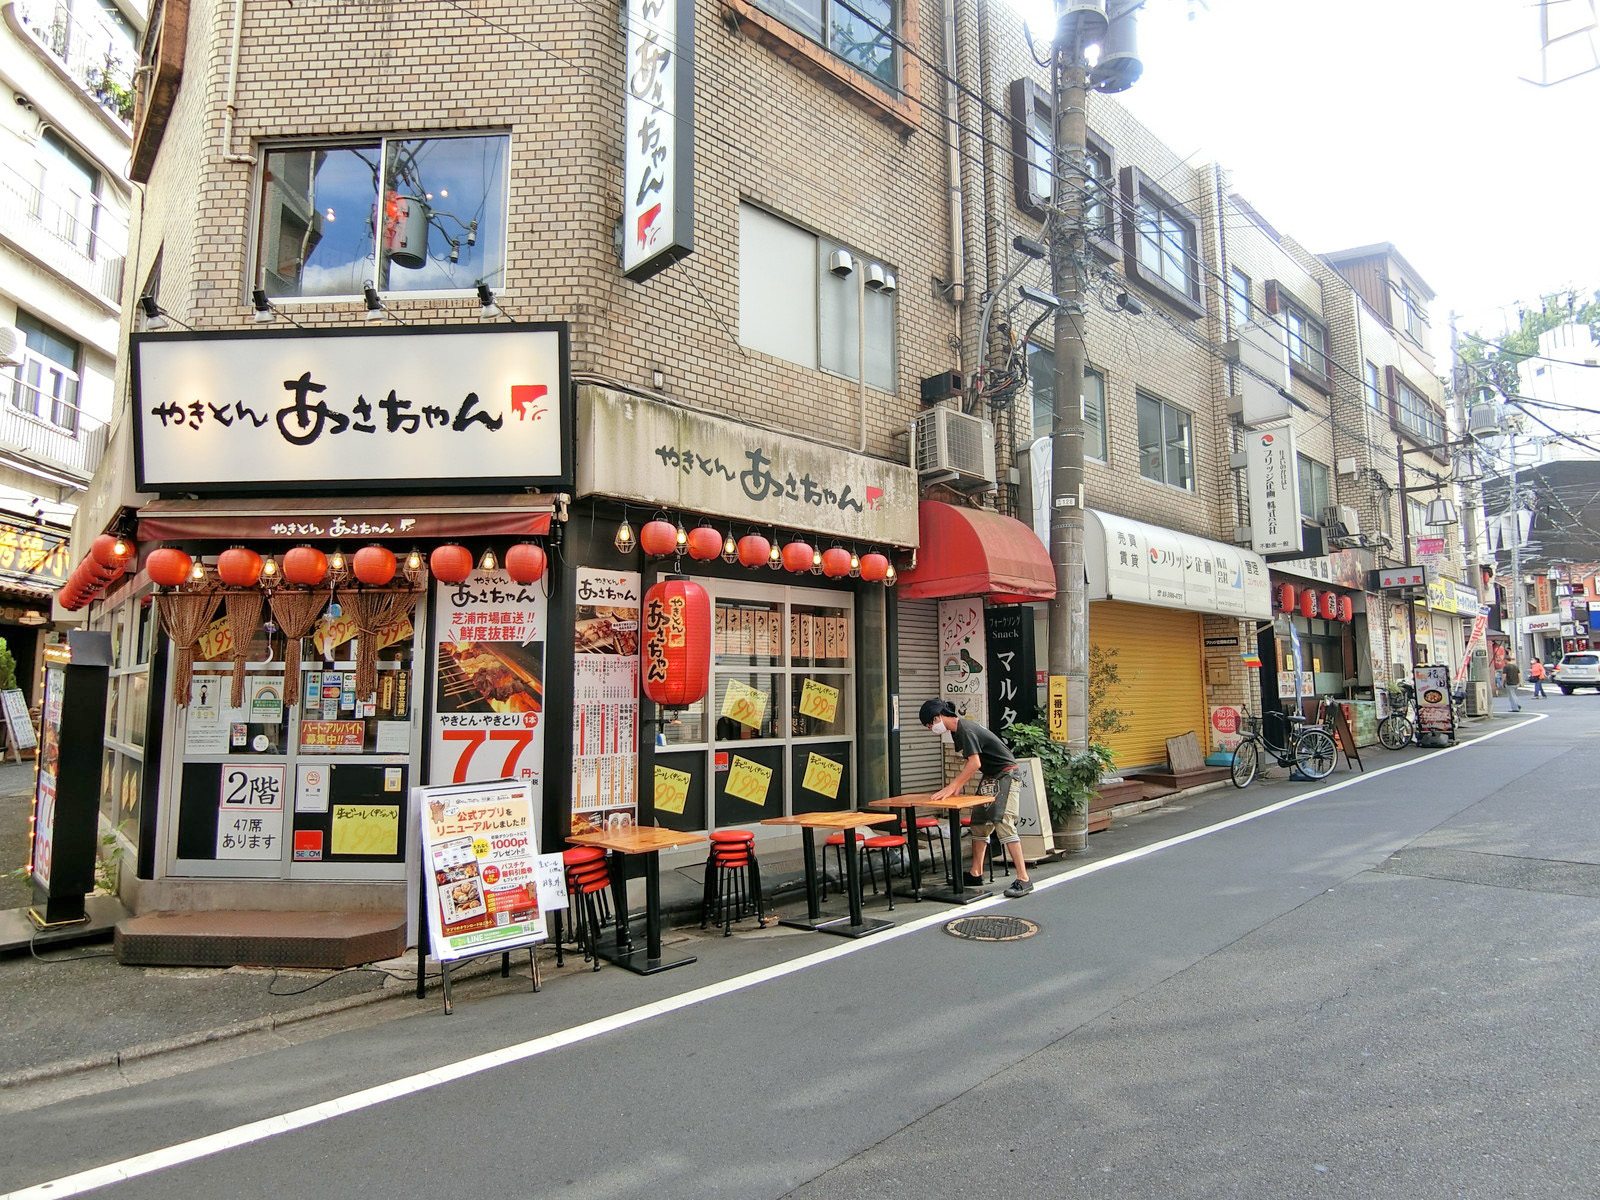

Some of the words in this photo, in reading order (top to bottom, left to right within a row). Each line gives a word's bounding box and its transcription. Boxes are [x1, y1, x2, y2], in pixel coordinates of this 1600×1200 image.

[151, 398, 268, 431] やきとん
[655, 445, 735, 482] やきとん
[270, 522, 325, 536] やきとん
[1117, 531, 1138, 549] 売買
[1260, 540, 1289, 549] 不動産一般
[452, 612, 535, 625] 芝浦市場直送!!
[989, 616, 1021, 627] フォークソング
[1529, 622, 1549, 630] Deepa
[459, 626, 525, 641] 鮮度抜群!!
[992, 629, 1020, 639] Snack
[325, 674, 341, 682] VISA
[946, 683, 968, 693] Goo!
[996, 651, 1018, 740] マルタ
[1053, 694, 1063, 728] 一番搾り
[1217, 709, 1234, 718] 防災
[440, 714, 520, 727] やきとん・やきとり
[524, 716, 537, 724] 1本
[1217, 718, 1235, 728] 減災
[303, 722, 363, 735] パート・アルバイト
[306, 733, 344, 745] 募集中!!
[442, 730, 534, 784] 77
[226, 771, 280, 806] 2階
[457, 807, 513, 822] 公式アプリを
[233, 818, 263, 832] 47席
[437, 817, 526, 836] リニューアルしました!!
[222, 833, 276, 849] あります
[490, 837, 529, 850] 1000pt
[295, 850, 321, 858] SECOM
[466, 933, 485, 944] LINE
